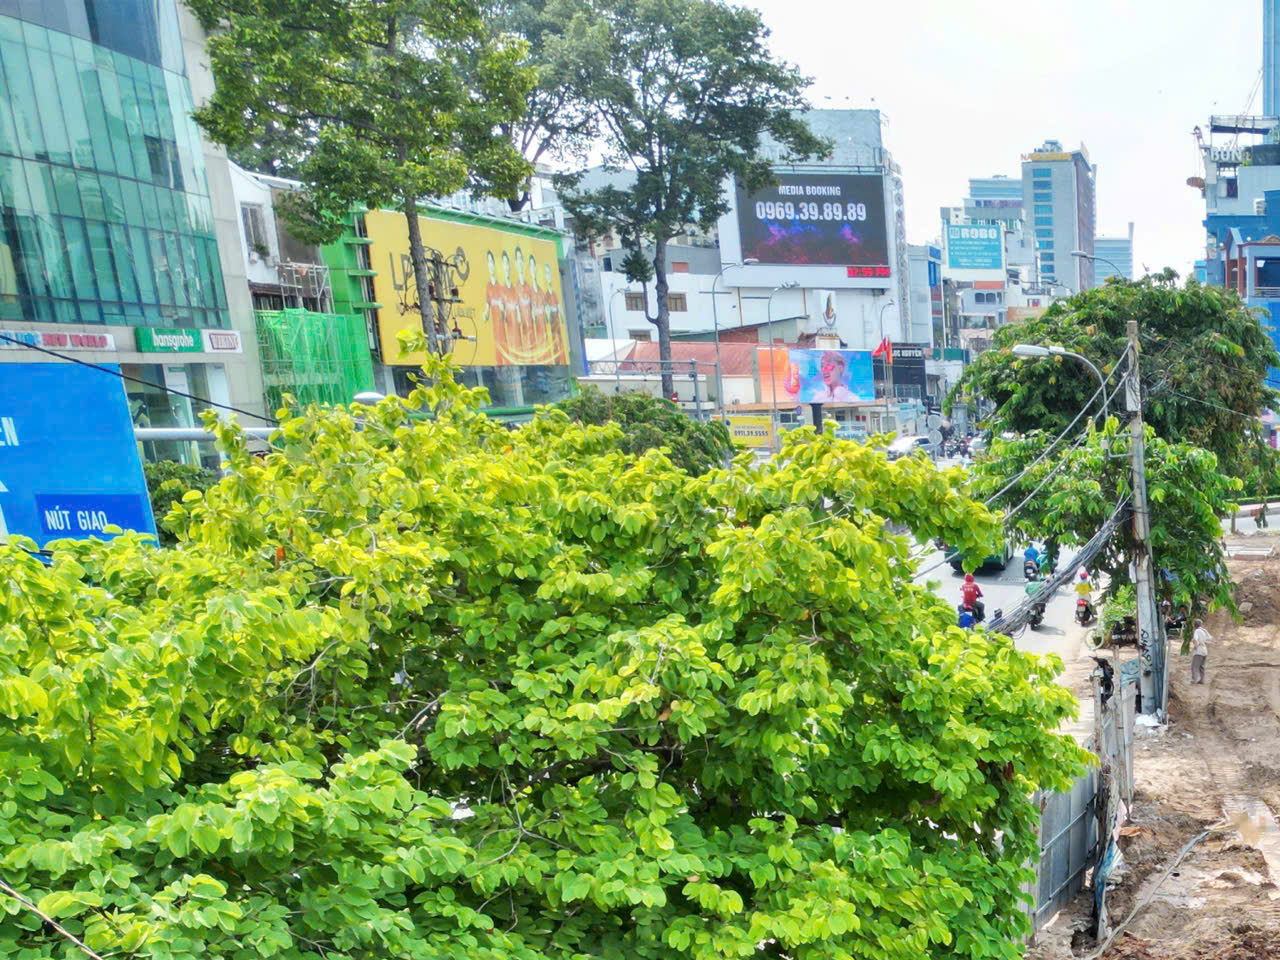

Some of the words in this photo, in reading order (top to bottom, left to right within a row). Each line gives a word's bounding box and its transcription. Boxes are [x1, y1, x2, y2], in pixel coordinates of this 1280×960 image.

[779, 185, 803, 196] MEDIA
[806, 186, 841, 196] BOOKING
[756, 201, 867, 221] 0969.39.89.89
[152, 327, 194, 351] hansgrohe
[45, 505, 71, 531] NÚT
[77, 510, 109, 531] GIAO
